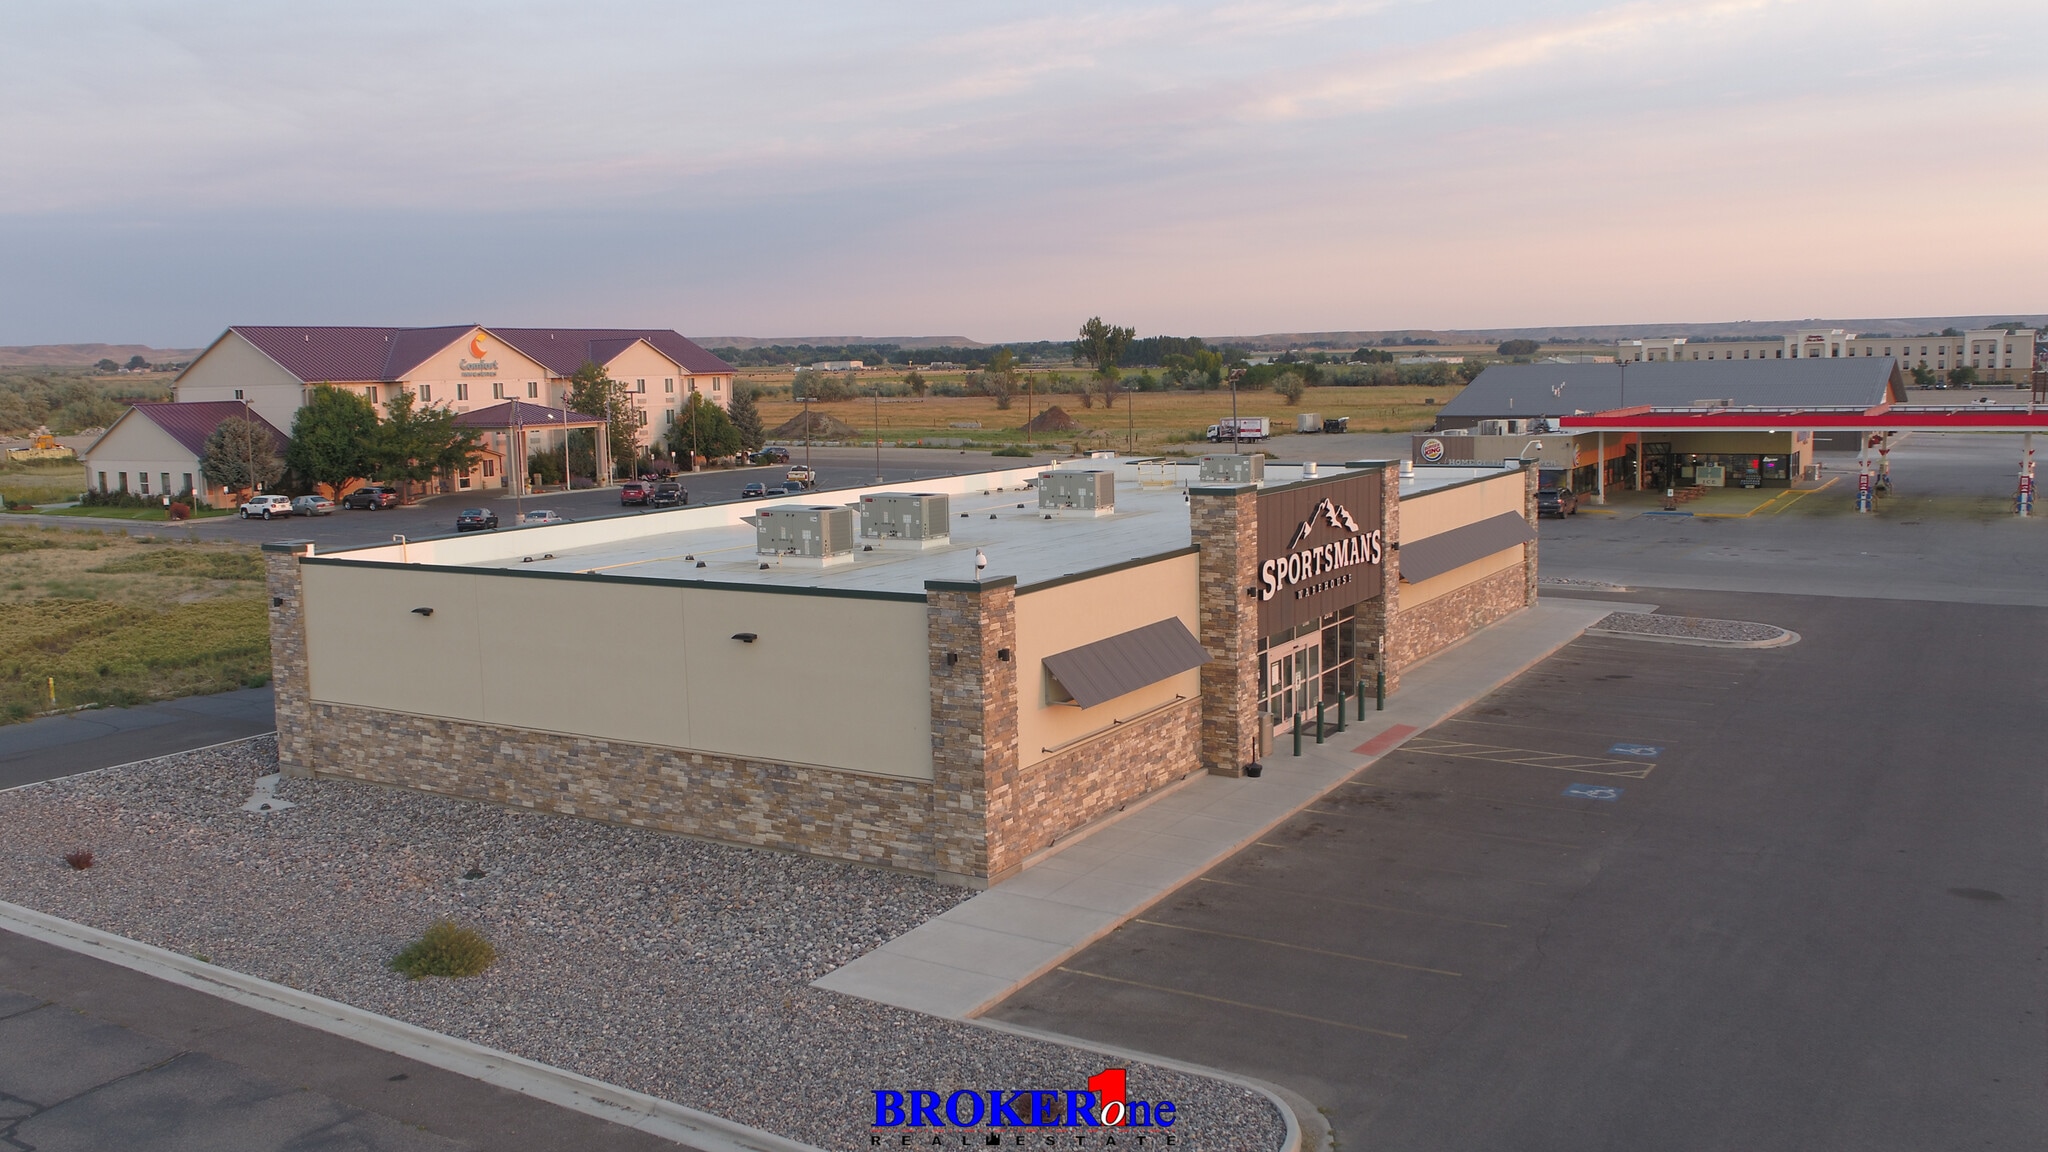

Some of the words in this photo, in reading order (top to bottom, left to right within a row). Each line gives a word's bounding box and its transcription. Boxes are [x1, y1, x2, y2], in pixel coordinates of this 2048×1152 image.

[459, 358, 499, 371] Comfort
[1425, 447, 1440, 455] KING
[1448, 458, 1474, 466] HOME
[1262, 529, 1382, 602] SPORTSMANS
